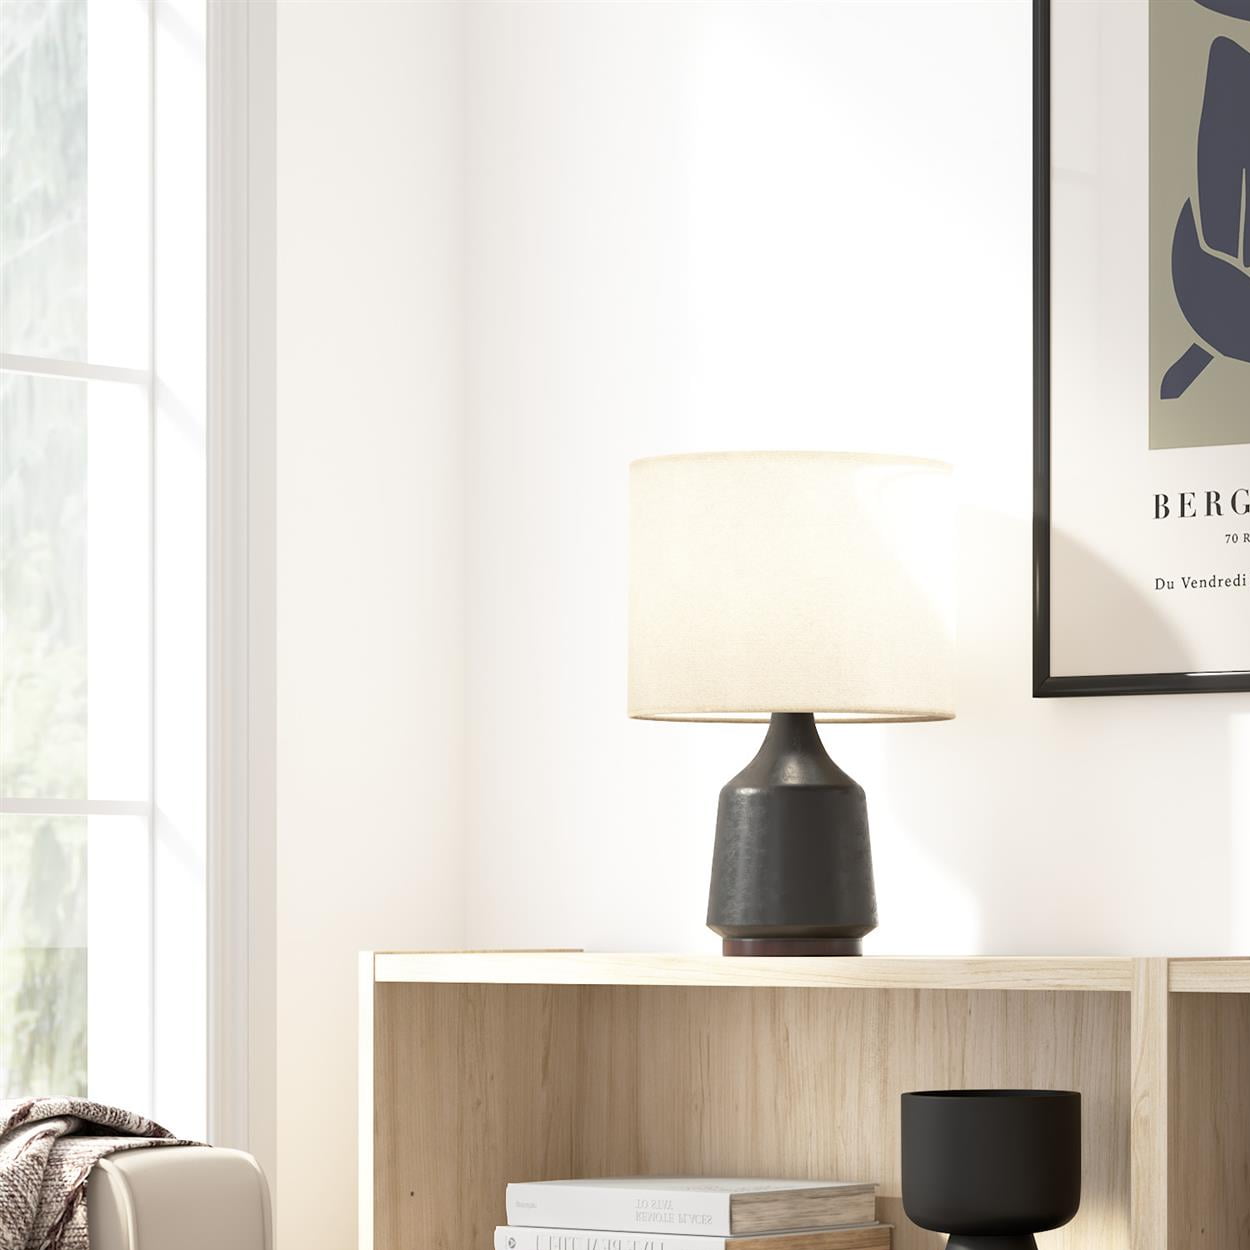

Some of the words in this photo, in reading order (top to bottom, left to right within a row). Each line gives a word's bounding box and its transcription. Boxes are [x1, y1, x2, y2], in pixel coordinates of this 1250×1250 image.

[1225, 533, 1238, 543] 70
[1155, 576, 1175, 590] Du
[1181, 572, 1246, 588] Vendredi
